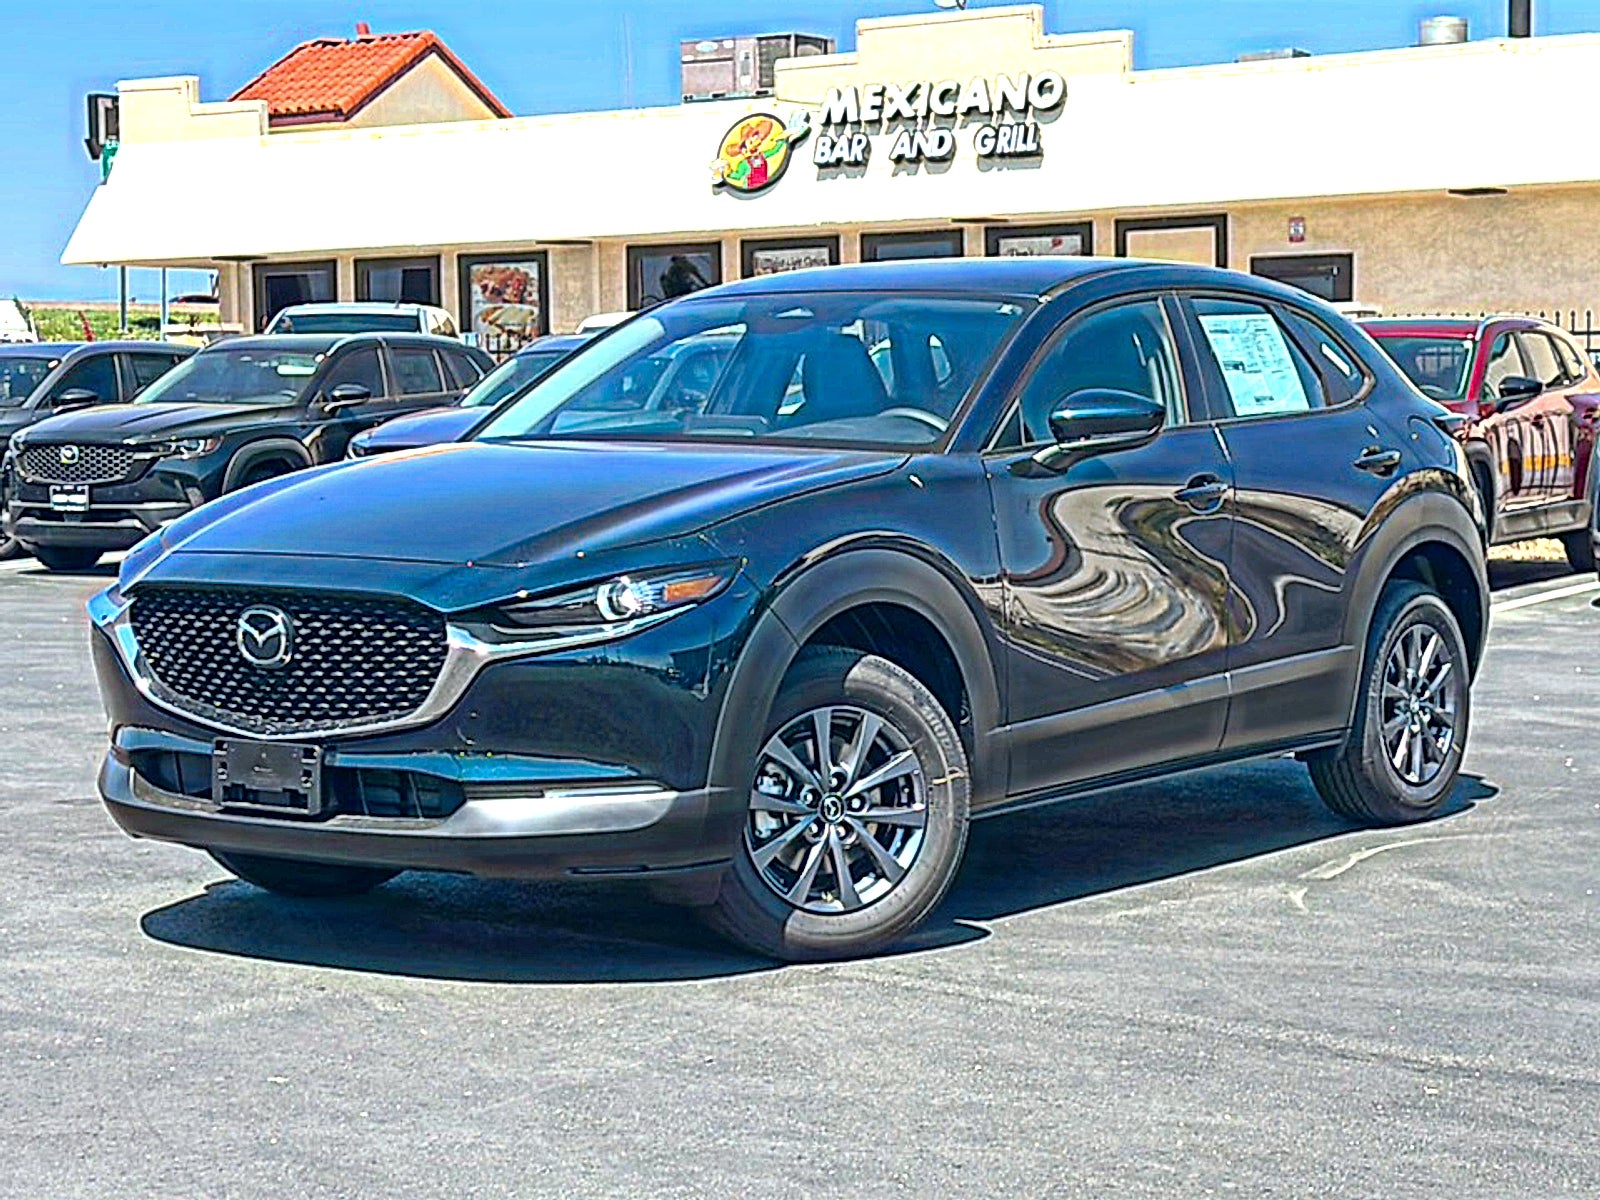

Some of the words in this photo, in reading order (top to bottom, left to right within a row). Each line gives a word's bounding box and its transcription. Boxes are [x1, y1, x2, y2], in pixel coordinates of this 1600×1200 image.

[820, 70, 1065, 126] MEXICANO
[814, 133, 870, 168] BAR
[889, 128, 955, 164] AND
[974, 122, 1041, 157] GRILL
